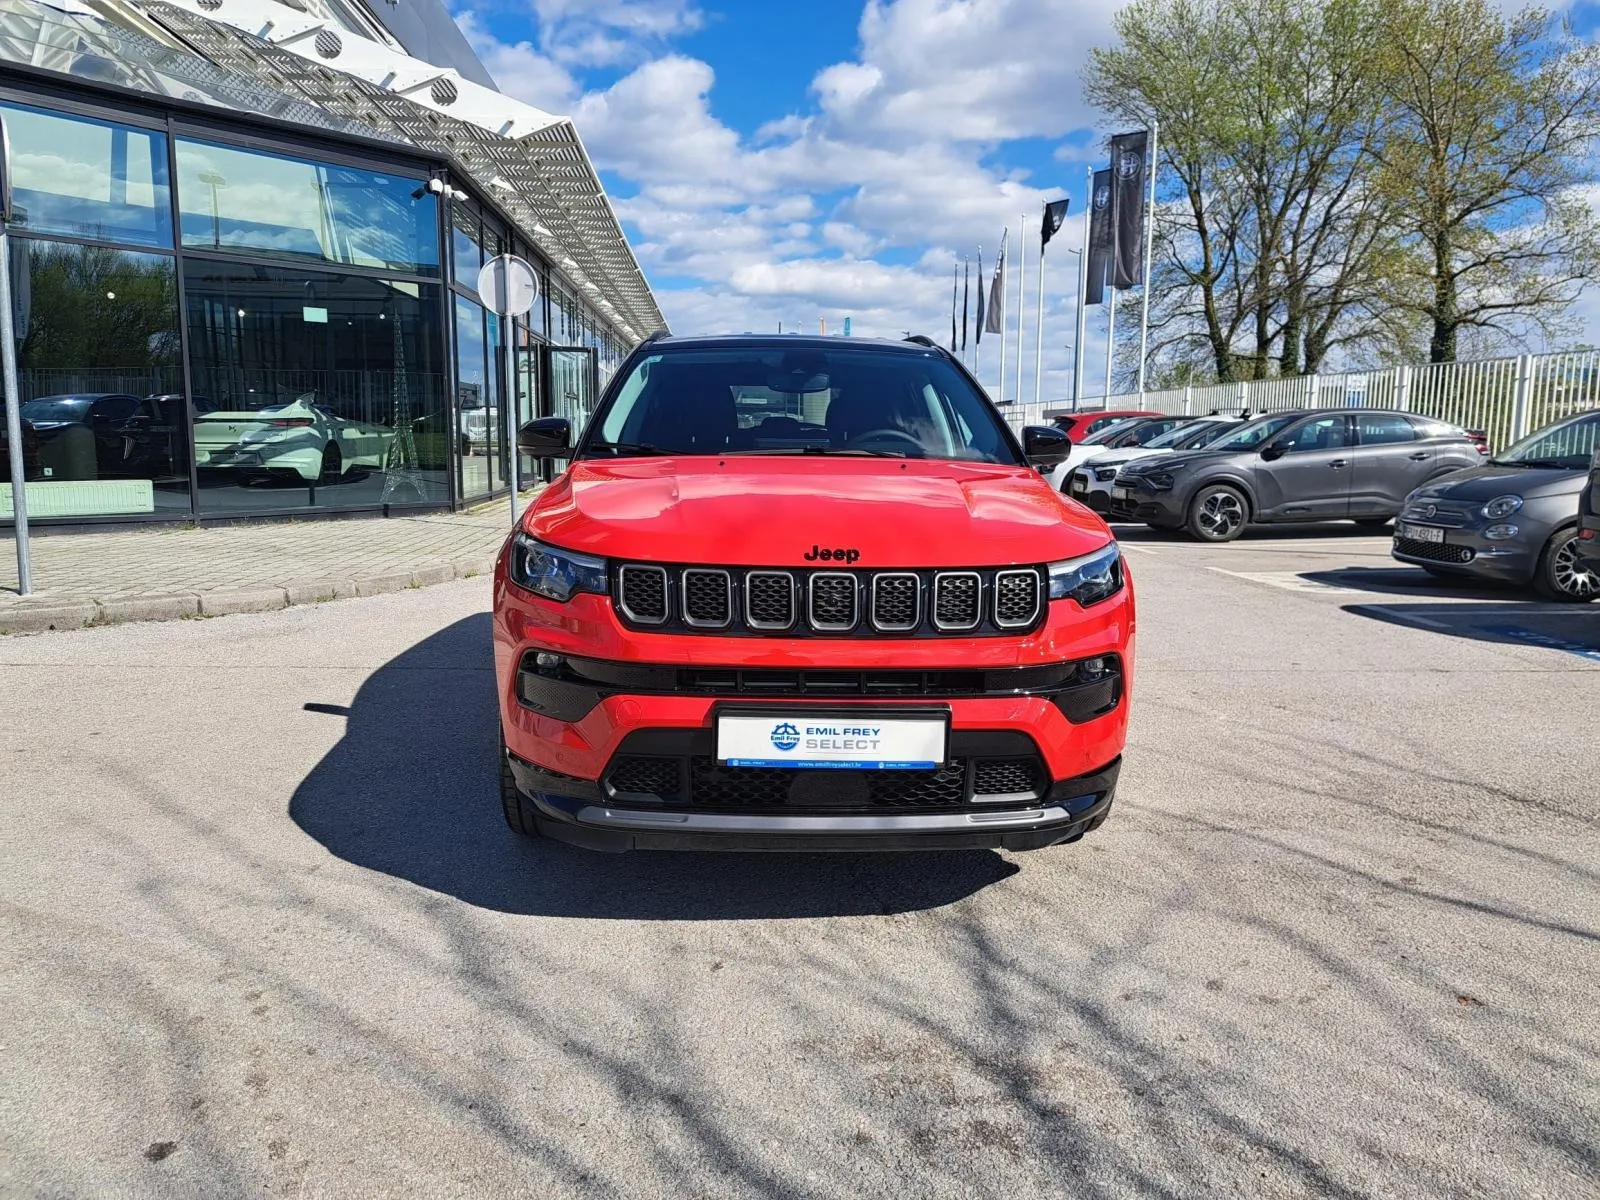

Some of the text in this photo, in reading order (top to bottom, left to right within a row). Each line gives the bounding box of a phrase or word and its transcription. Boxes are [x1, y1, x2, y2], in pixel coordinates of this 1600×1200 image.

[803, 545, 860, 564] Jeep
[806, 727, 880, 736] EMIL FREY
[806, 739, 880, 750] SELECT
